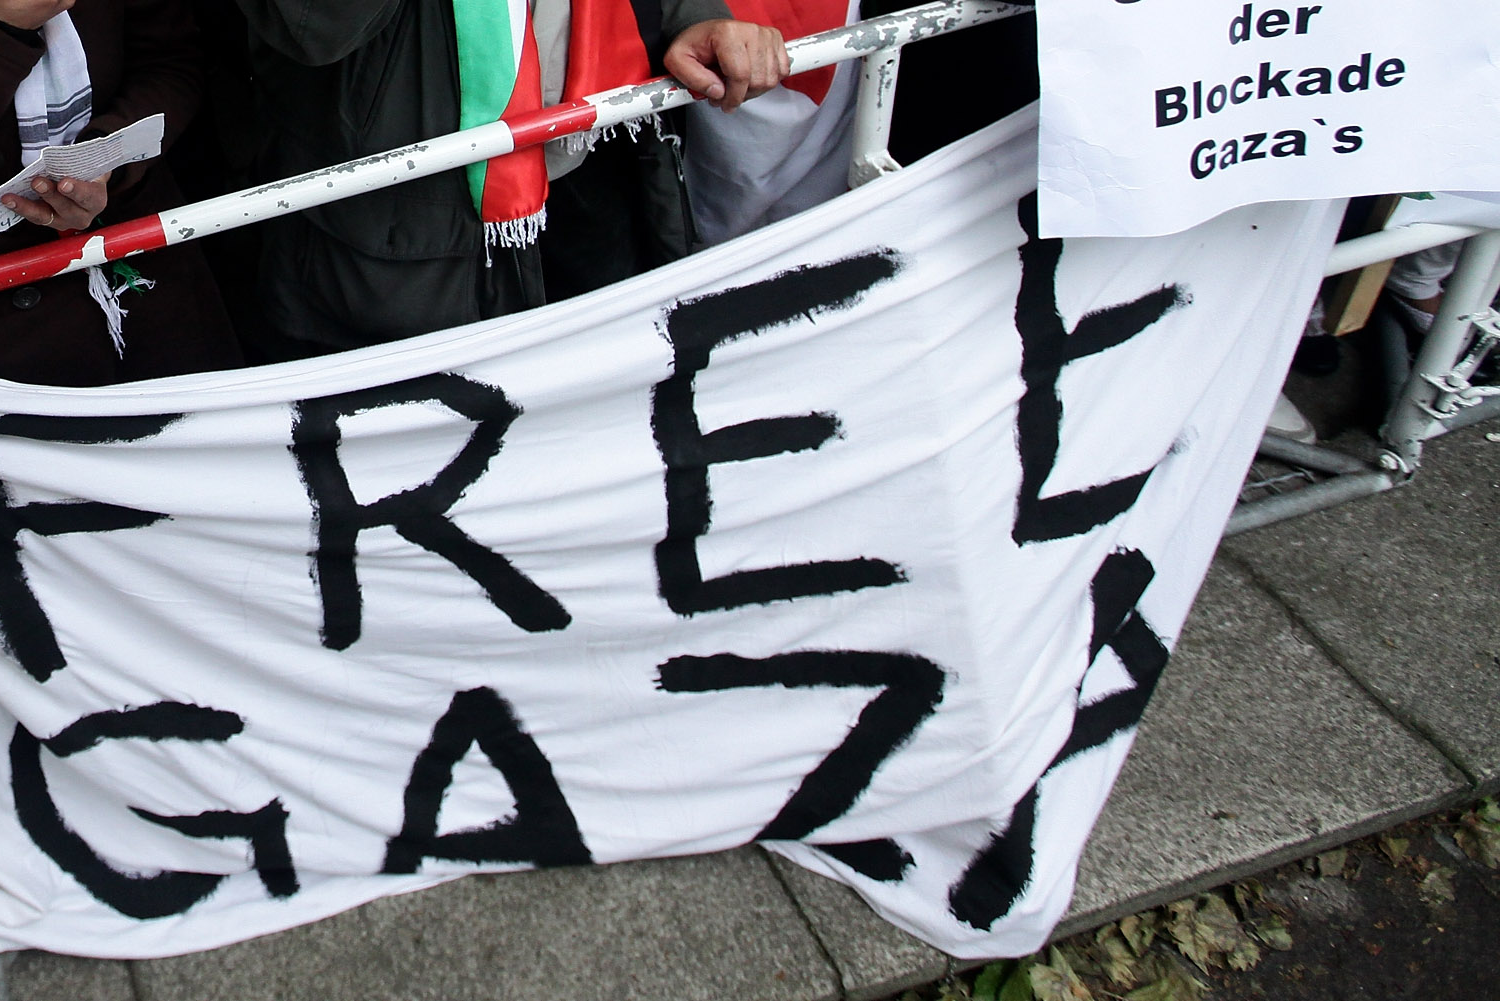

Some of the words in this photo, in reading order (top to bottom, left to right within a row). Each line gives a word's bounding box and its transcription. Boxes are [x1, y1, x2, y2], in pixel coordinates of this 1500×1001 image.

[1228, 3, 1322, 46] der
[1154, 52, 1406, 128] Blockade
[8, 546, 1170, 931] GAZA
